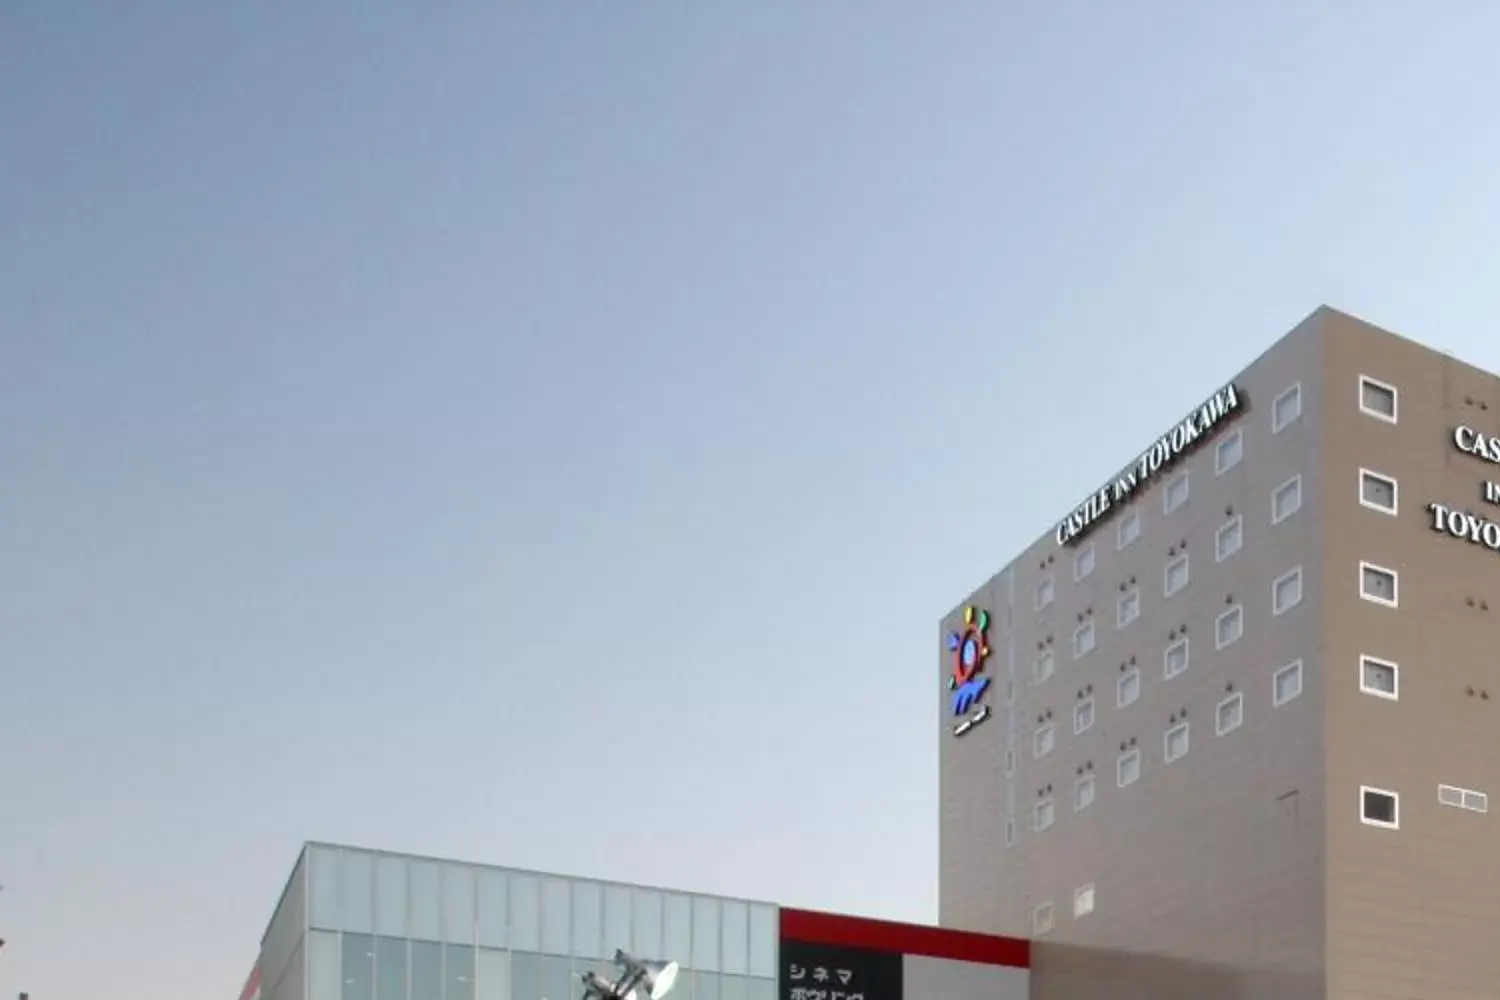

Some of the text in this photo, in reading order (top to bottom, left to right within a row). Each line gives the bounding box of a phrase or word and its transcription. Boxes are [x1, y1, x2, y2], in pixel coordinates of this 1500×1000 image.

[1056, 383, 1239, 547] CASTLE INN TOYOKAWA
[789, 963, 853, 985] シネマ
